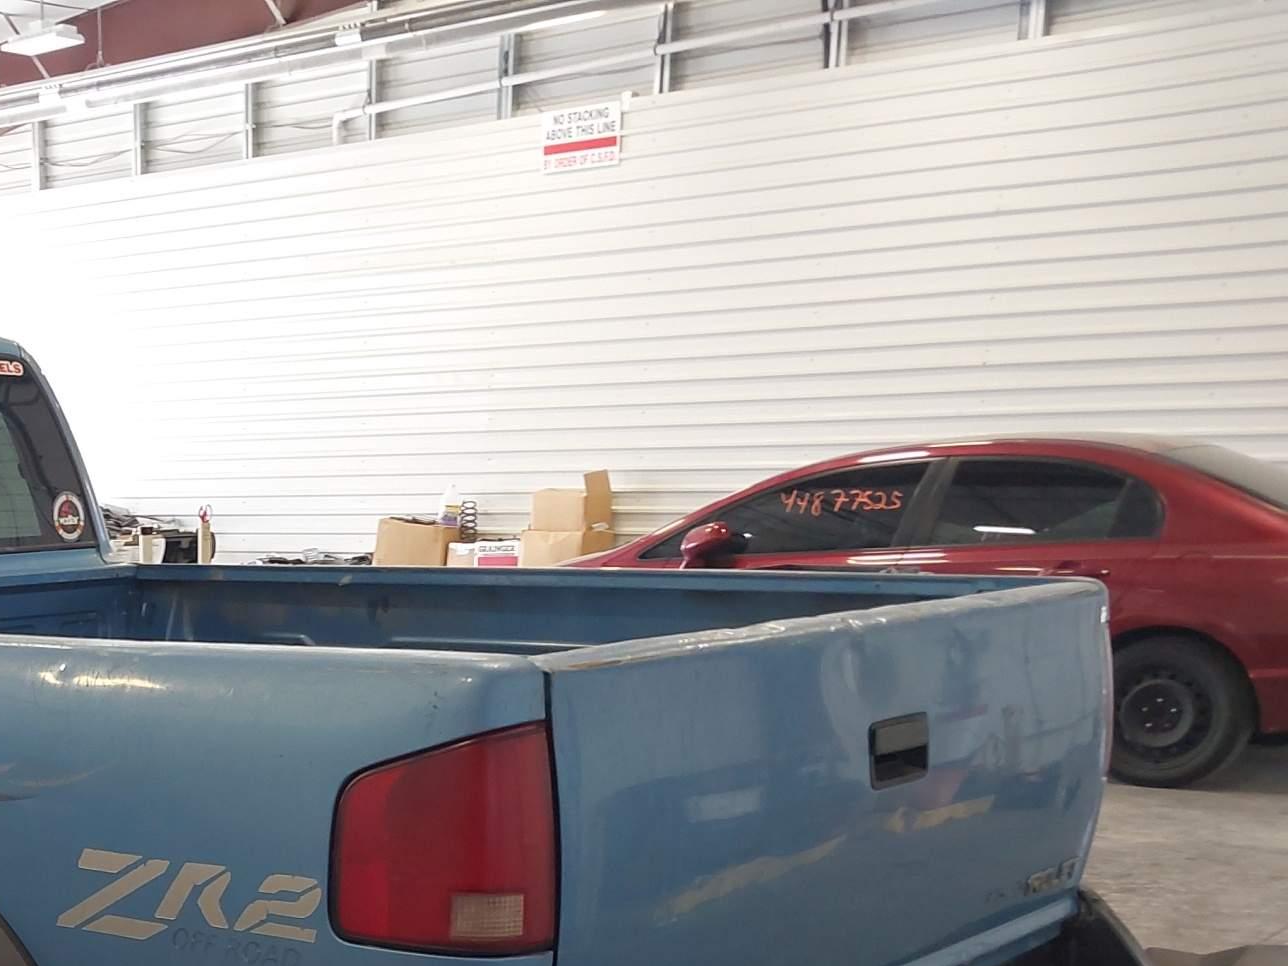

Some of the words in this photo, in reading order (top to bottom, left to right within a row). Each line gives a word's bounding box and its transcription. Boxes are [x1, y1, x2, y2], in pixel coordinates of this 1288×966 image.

[553, 113, 566, 125] NO
[567, 106, 609, 124] STACKING
[545, 126, 574, 141] ABOVE
[576, 122, 595, 137] THIS
[596, 119, 617, 134] LINE
[56, 848, 322, 943] ZR2
[171, 927, 217, 953] OFF
